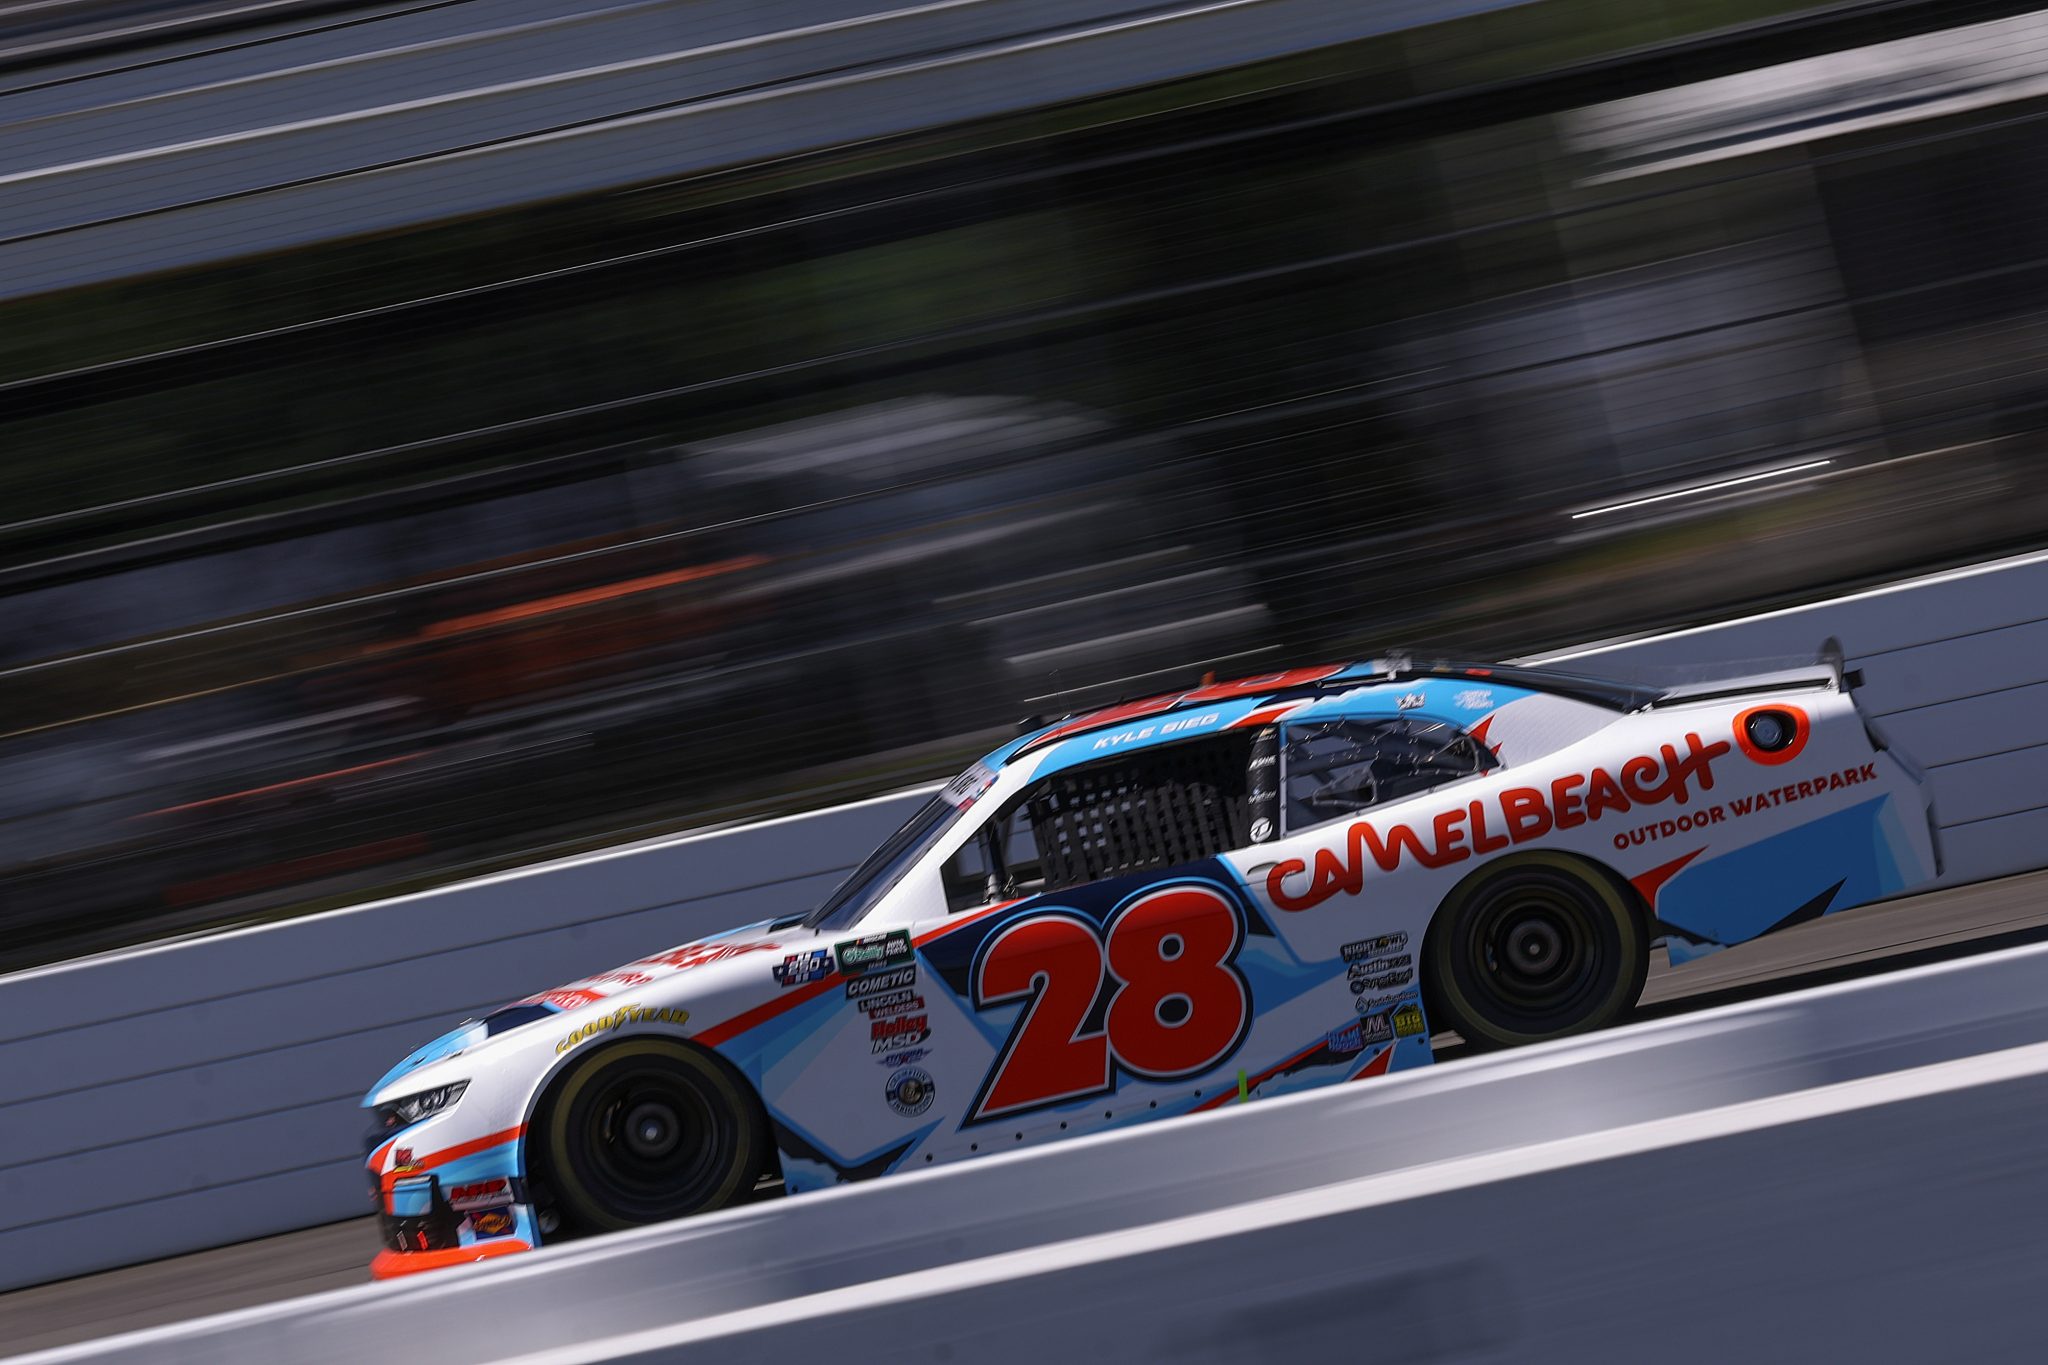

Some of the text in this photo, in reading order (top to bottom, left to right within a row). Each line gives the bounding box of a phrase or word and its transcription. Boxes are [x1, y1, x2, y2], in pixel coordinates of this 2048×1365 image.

[1093, 713, 1220, 750] KYLE SIEG
[1613, 763, 1878, 850] OUTDOOR WATERPARK
[1266, 732, 1731, 913] CAMELBEACH
[849, 970, 914, 995] COMETIC
[861, 990, 912, 1010] LINCOLN
[874, 1001, 919, 1018] WELDERS
[974, 884, 1244, 1119] 28
[555, 1003, 690, 1055] GOODYEAR
[871, 1014, 928, 1039] Holley
[872, 1032, 922, 1054] MSD
